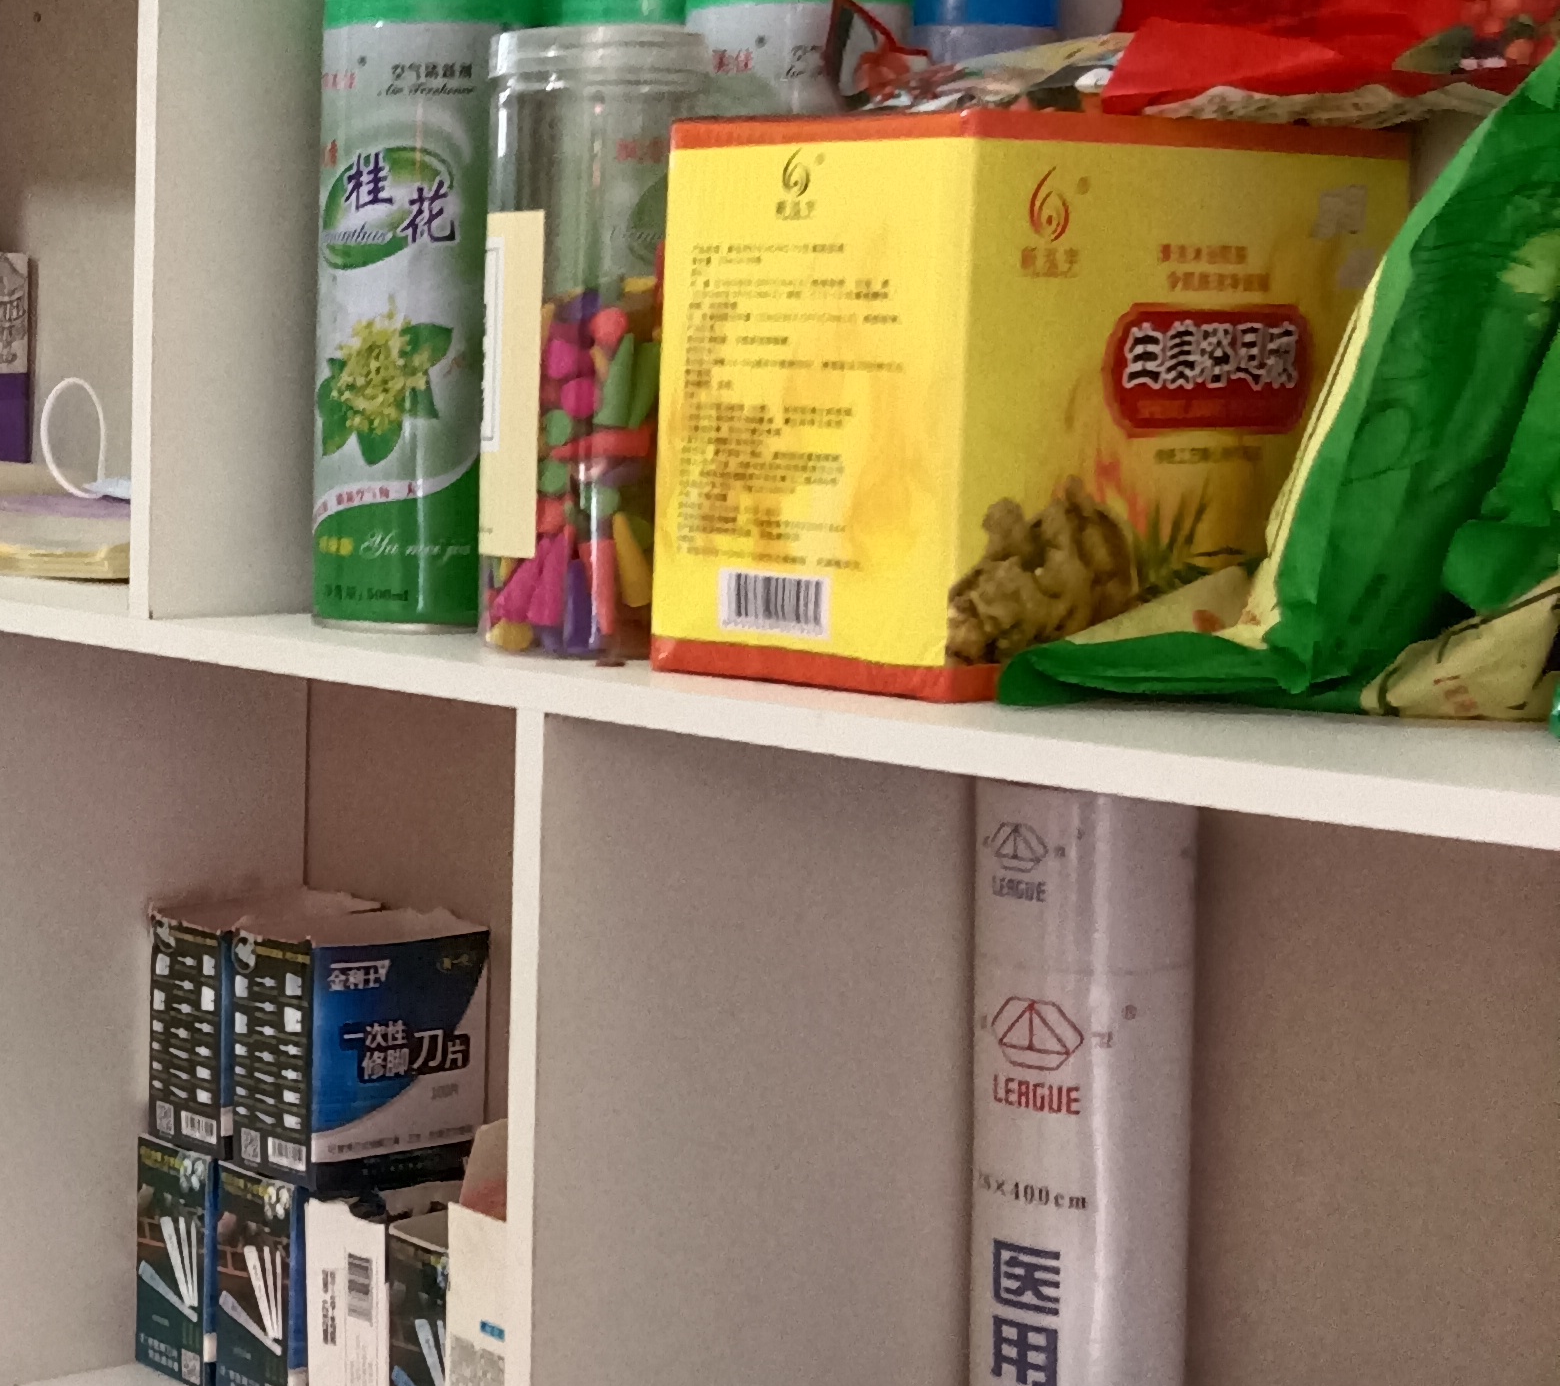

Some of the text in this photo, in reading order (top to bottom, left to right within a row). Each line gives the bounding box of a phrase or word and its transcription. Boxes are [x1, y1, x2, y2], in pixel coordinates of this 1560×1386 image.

[344, 151, 456, 244] 桂花
[991, 875, 1048, 903] LEAGUE
[343, 1020, 408, 1048] 一次性
[361, 1047, 410, 1080] 修脚
[992, 1073, 1082, 1115] LEAGUE
